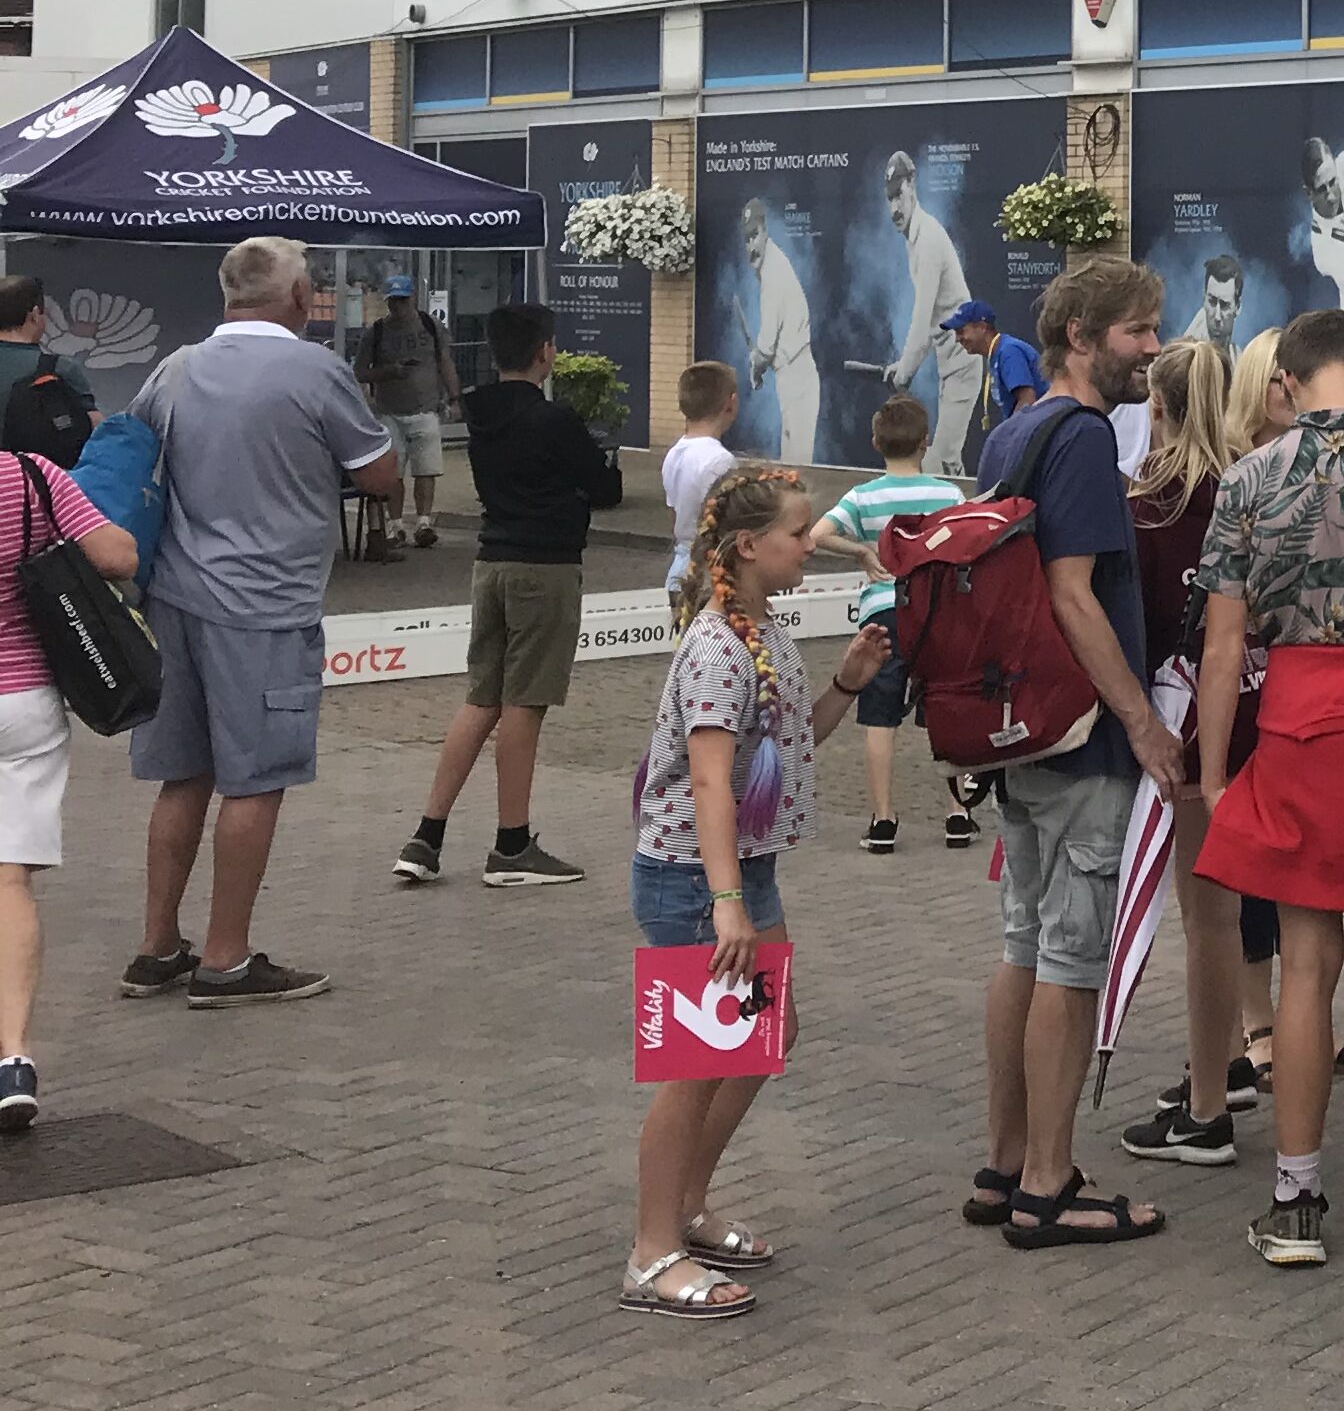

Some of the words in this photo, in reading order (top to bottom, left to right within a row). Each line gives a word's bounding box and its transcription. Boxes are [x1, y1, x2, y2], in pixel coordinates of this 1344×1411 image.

[706, 142, 728, 155] Made
[731, 141, 738, 154] in
[740, 139, 777, 154] Yorkshire:
[706, 157, 751, 173] ENGLAND'S
[753, 156, 772, 171] TEST
[774, 154, 804, 170] MATCH
[807, 152, 849, 169] CAPTAINS
[143, 168, 363, 188] YORKSHIRE
[154, 187, 233, 197] CRICKET
[242, 186, 372, 197] FOUNDATION
[558, 180, 622, 204] YORKSHIRE
[1173, 193, 1202, 202] NORMAN
[30, 201, 521, 226] wwwyorkshirecricketfoundation.com
[1173, 203, 1219, 218] YARDLEY
[1007, 262, 1061, 276] STANYFORTH
[560, 275, 577, 289] ROLL
[578, 275, 588, 289] OF
[589, 275, 620, 289] HONOUR
[594, 624, 665, 647] 654300
[638, 978, 671, 1050] Vitality
[673, 970, 760, 1051] 6
